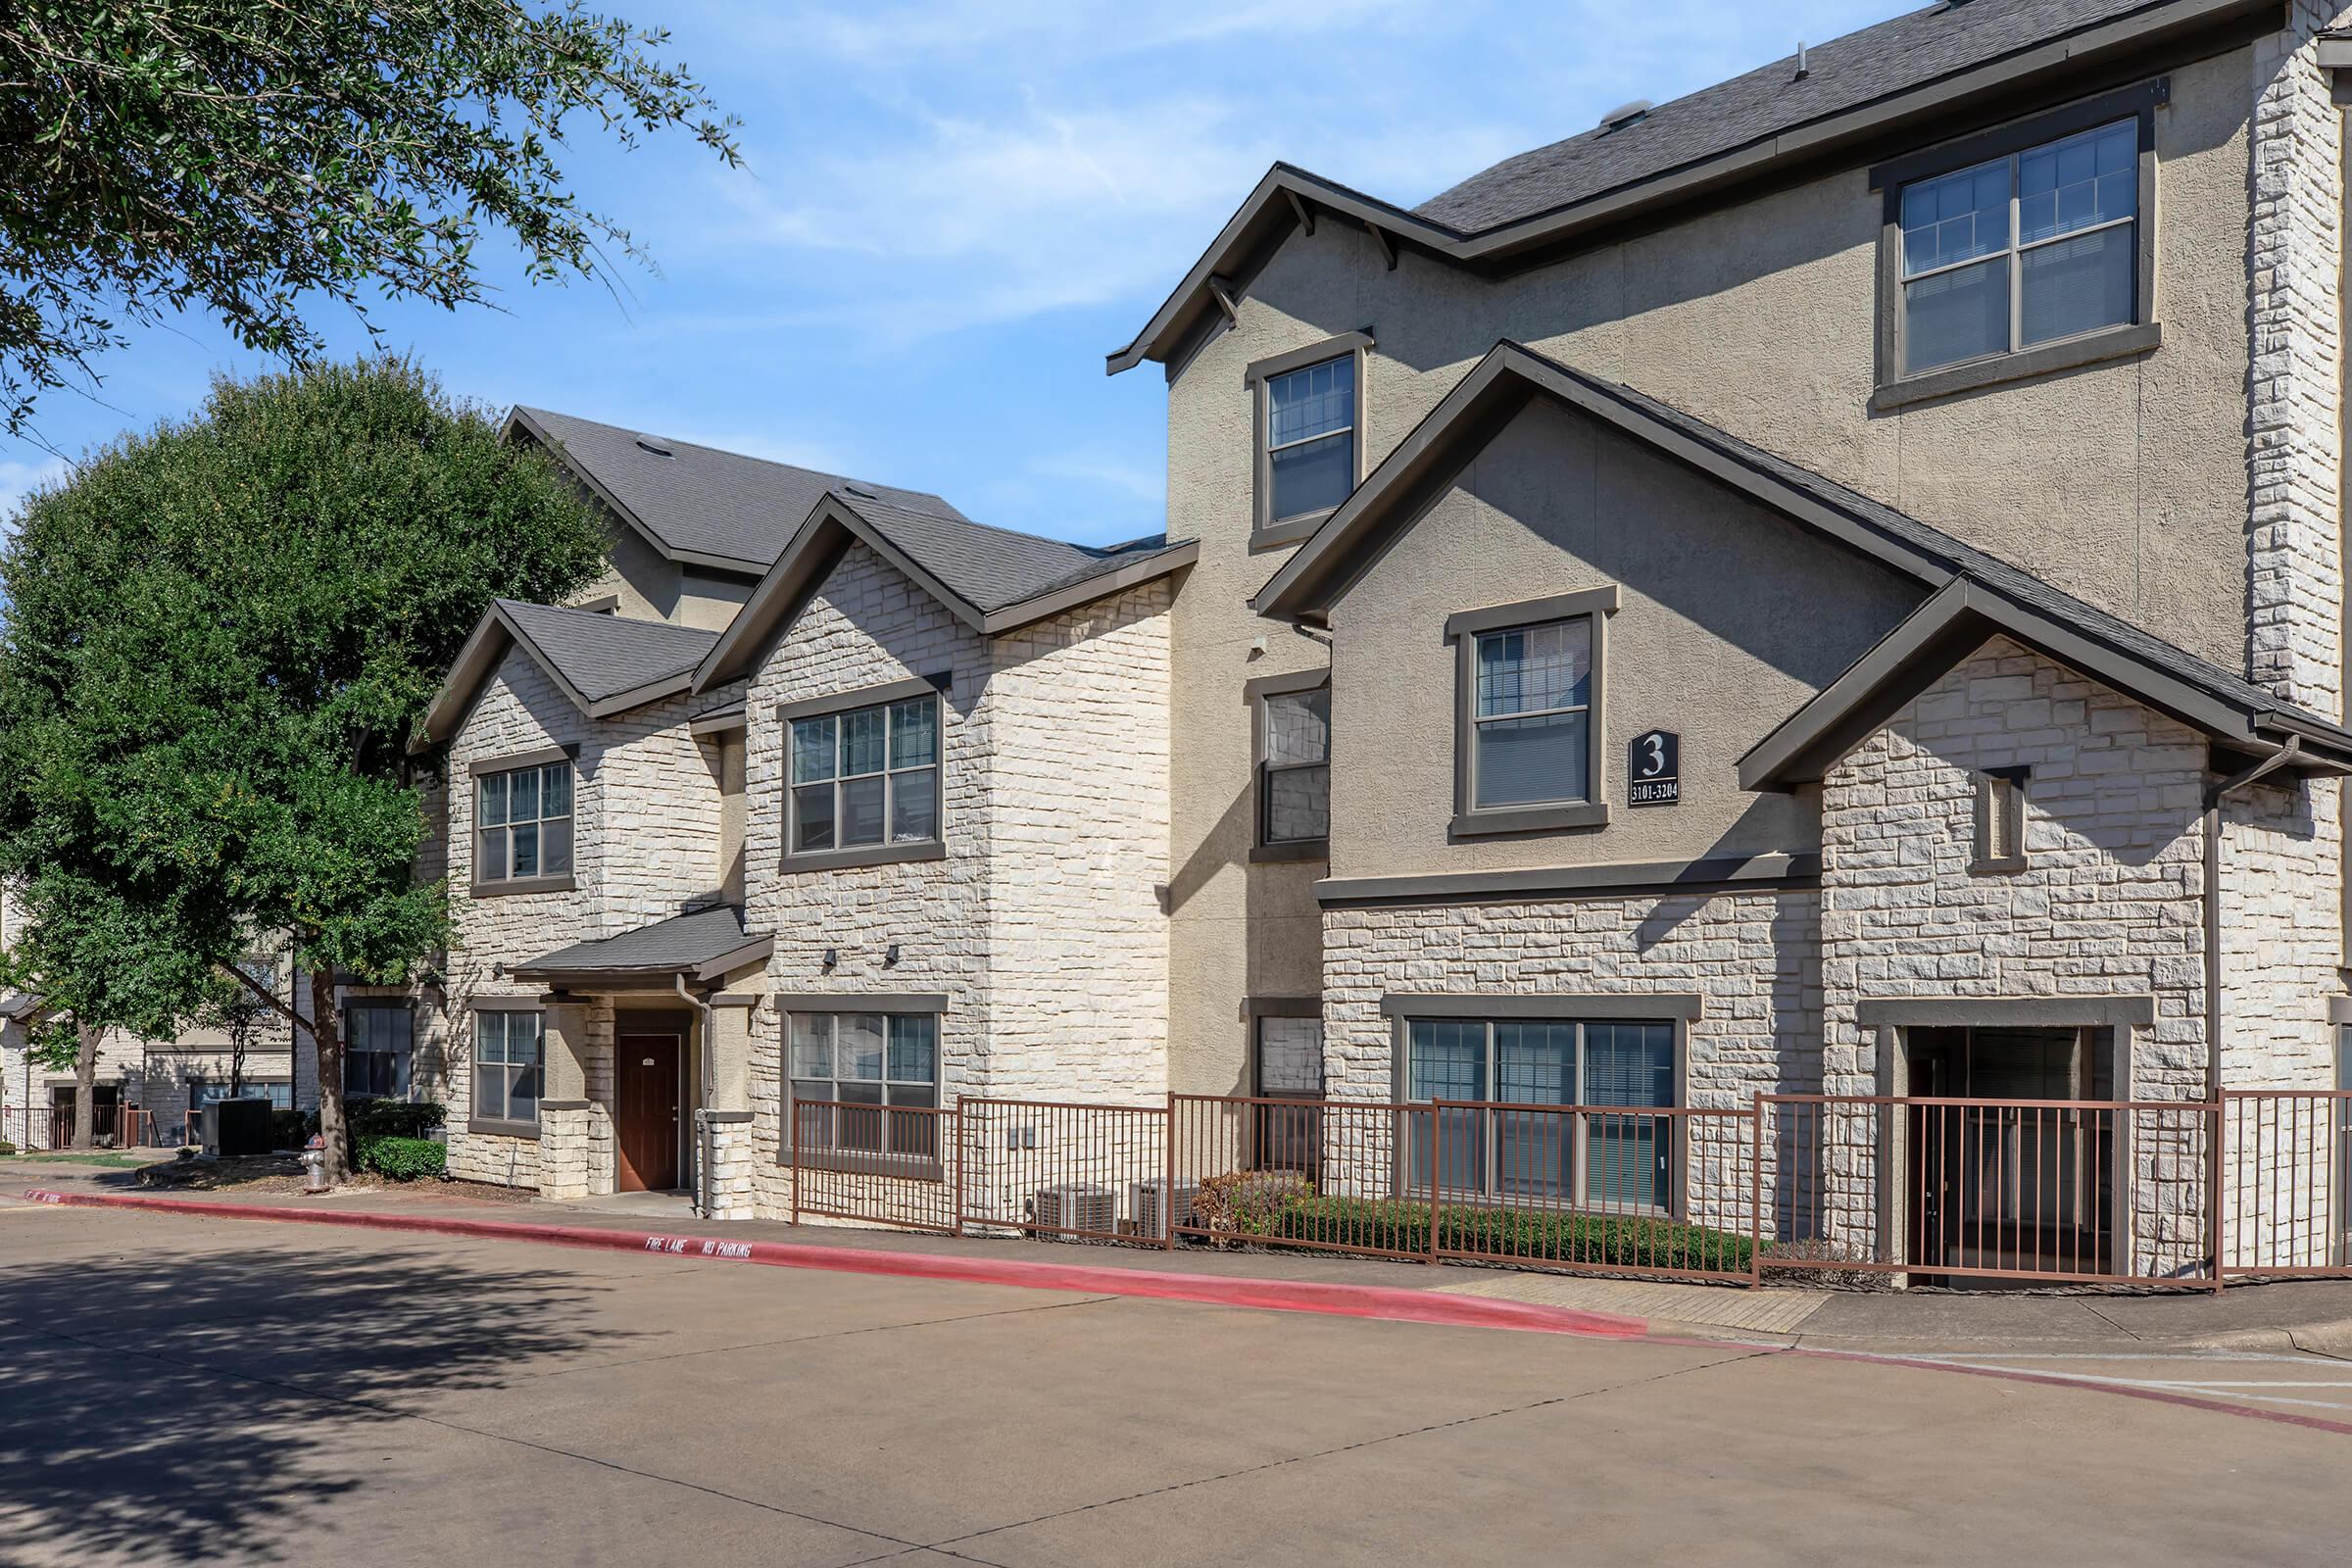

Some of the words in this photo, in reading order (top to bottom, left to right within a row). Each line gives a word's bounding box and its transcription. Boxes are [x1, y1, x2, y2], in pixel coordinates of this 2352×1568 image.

[1642, 734, 1664, 776] 3
[1632, 783, 1678, 801] 3101-3204
[645, 1237, 664, 1250] FIRE
[665, 1239, 688, 1253] LANE
[702, 1241, 715, 1254] NO
[715, 1242, 752, 1257] PARKING
